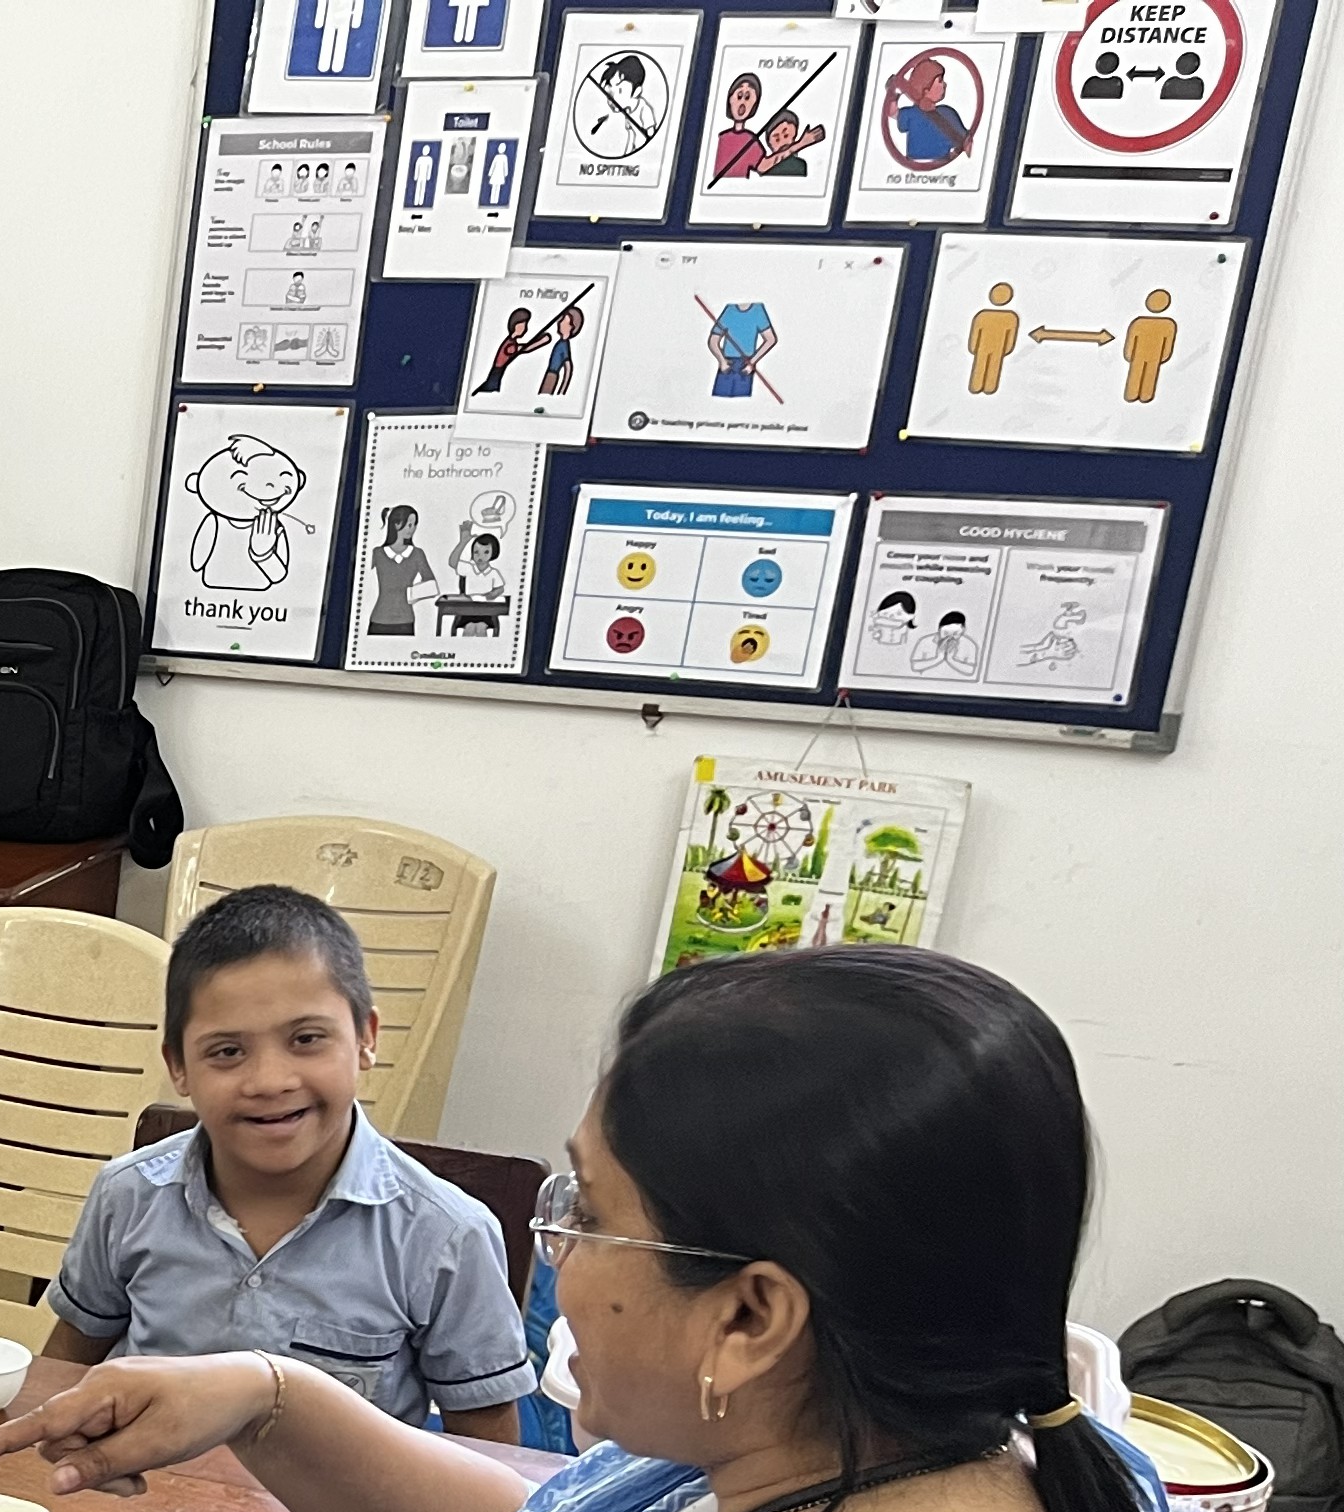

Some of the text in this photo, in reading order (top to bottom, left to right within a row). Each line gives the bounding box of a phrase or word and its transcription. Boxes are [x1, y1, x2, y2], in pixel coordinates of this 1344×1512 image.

[1130, 4, 1186, 22] KEEP
[1100, 26, 1207, 44] DISTANCE
[758, 56, 808, 72] no biting
[453, 115, 479, 129] Toilet
[258, 138, 332, 151] School Rules
[579, 163, 640, 177] NO SPITTING
[886, 172, 957, 187] no throwing
[519, 287, 568, 302] no hitting
[413, 441, 491, 462] May I go to
[403, 461, 504, 479] the bathroom?
[645, 509, 687, 523] Today,
[696, 514, 717, 524] am
[959, 525, 1069, 542] GOOD HYGIENE
[625, 539, 657, 550] Happy
[184, 596, 288, 625] thank you
[755, 769, 900, 794] AMUSEMENT PARK
